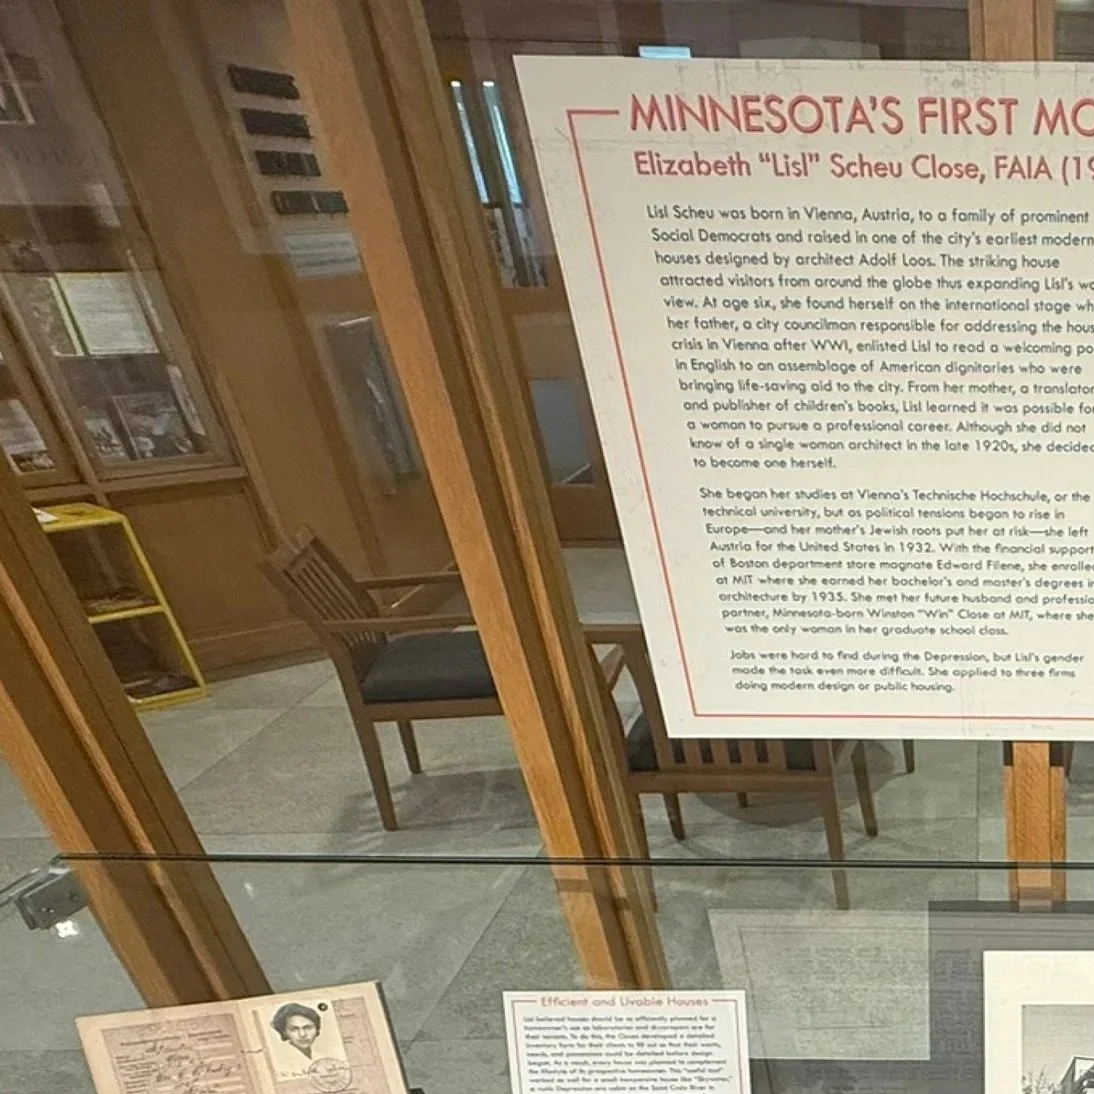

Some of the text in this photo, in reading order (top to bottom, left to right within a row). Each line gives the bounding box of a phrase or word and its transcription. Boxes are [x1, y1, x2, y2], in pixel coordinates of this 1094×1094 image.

[918, 97, 1019, 135] FIRST
[634, 151, 751, 176] Elizabeth
[830, 153, 902, 177] Scheu
[911, 154, 985, 183] Close,
[994, 155, 1052, 179] FAIA
[646, 205, 1089, 225] Lisl Scheu was born in Vienna, Austria, to a family of prominent
[651, 228, 694, 241] Social
[698, 228, 771, 242] Democrats
[775, 229, 803, 243] and
[808, 230, 851, 243] raised
[855, 230, 867, 243] in
[872, 234, 896, 244] one
[902, 230, 916, 244] of
[921, 231, 943, 244] the
[986, 232, 1037, 245] earliest
[1041, 232, 1094, 246] modern
[663, 296, 698, 308] view.
[703, 296, 717, 308] At
[722, 299, 749, 311] age
[754, 296, 776, 310] six,
[780, 296, 801, 309] she
[806, 296, 844, 309] found
[849, 296, 893, 309] herself
[899, 300, 916, 310] on
[920, 298, 940, 310] the
[945, 298, 1029, 311] international
[1034, 301, 1071, 314] stage
[699, 487, 722, 499] She
[726, 488, 767, 501] began
[770, 488, 790, 499] her
[795, 489, 837, 499] studies
[840, 490, 853, 499] at
[912, 489, 976, 500] Technische
[980, 490, 1050, 503] Hochschule,
[1054, 494, 1067, 502] or
[1072, 491, 1090, 502] the
[735, 680, 767, 691] doing
[771, 681, 814, 690] modern
[817, 681, 854, 692] design
[874, 682, 907, 692] public
[910, 682, 955, 693] housing.
[540, 996, 708, 1006] Efficient and Livable Houses
